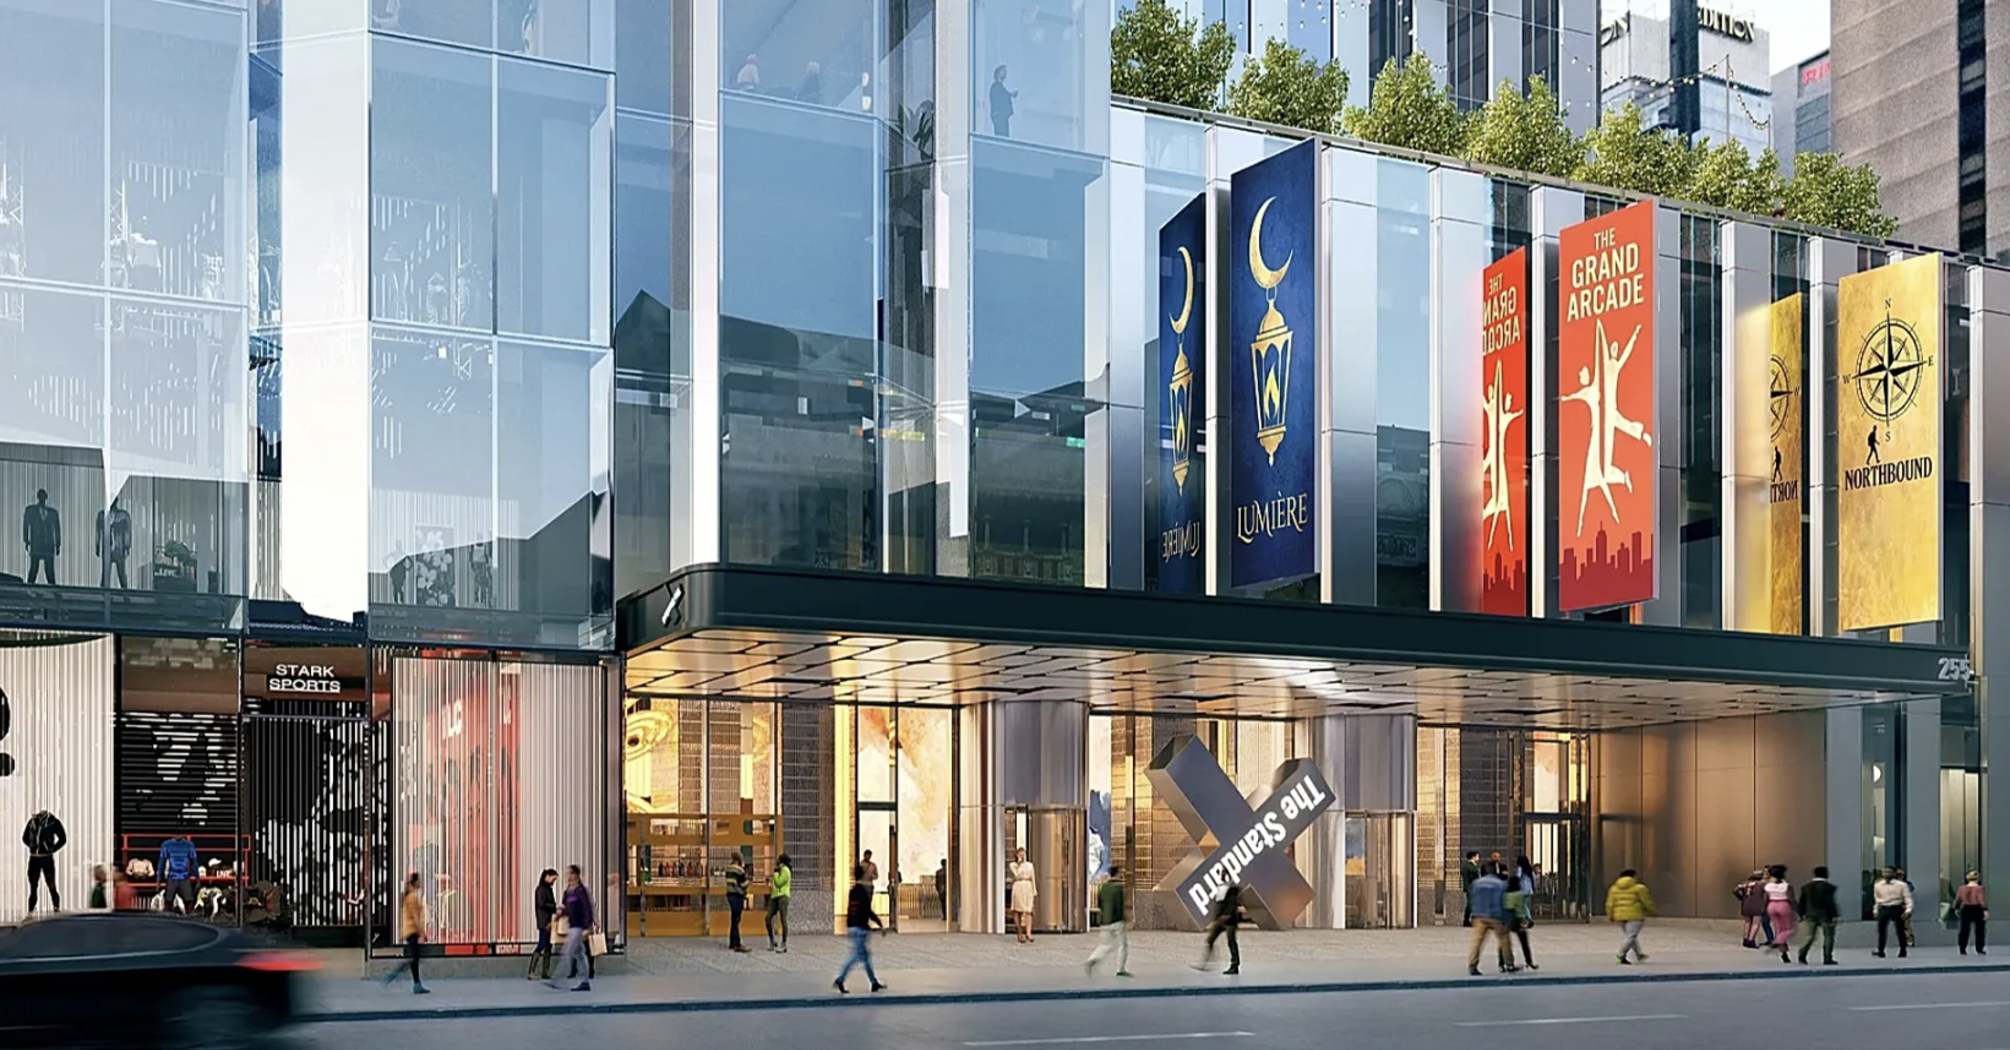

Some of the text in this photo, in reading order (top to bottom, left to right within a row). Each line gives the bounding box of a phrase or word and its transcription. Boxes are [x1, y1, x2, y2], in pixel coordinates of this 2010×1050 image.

[1594, 227, 1616, 251] THE
[1572, 242, 1639, 289] GRAND
[1567, 273, 1644, 323] ARCADE
[1884, 299, 1891, 309] N
[1843, 355, 1935, 385] W E
[1884, 431, 1891, 442] S
[1845, 456, 1933, 491] NORTHBOUND
[1237, 490, 1309, 544] LUMIÈRE
[276, 663, 335, 678] STARK
[1938, 657, 1970, 680] 255
[269, 678, 341, 693] SPORTS
[1187, 774, 1327, 916] The Standard
